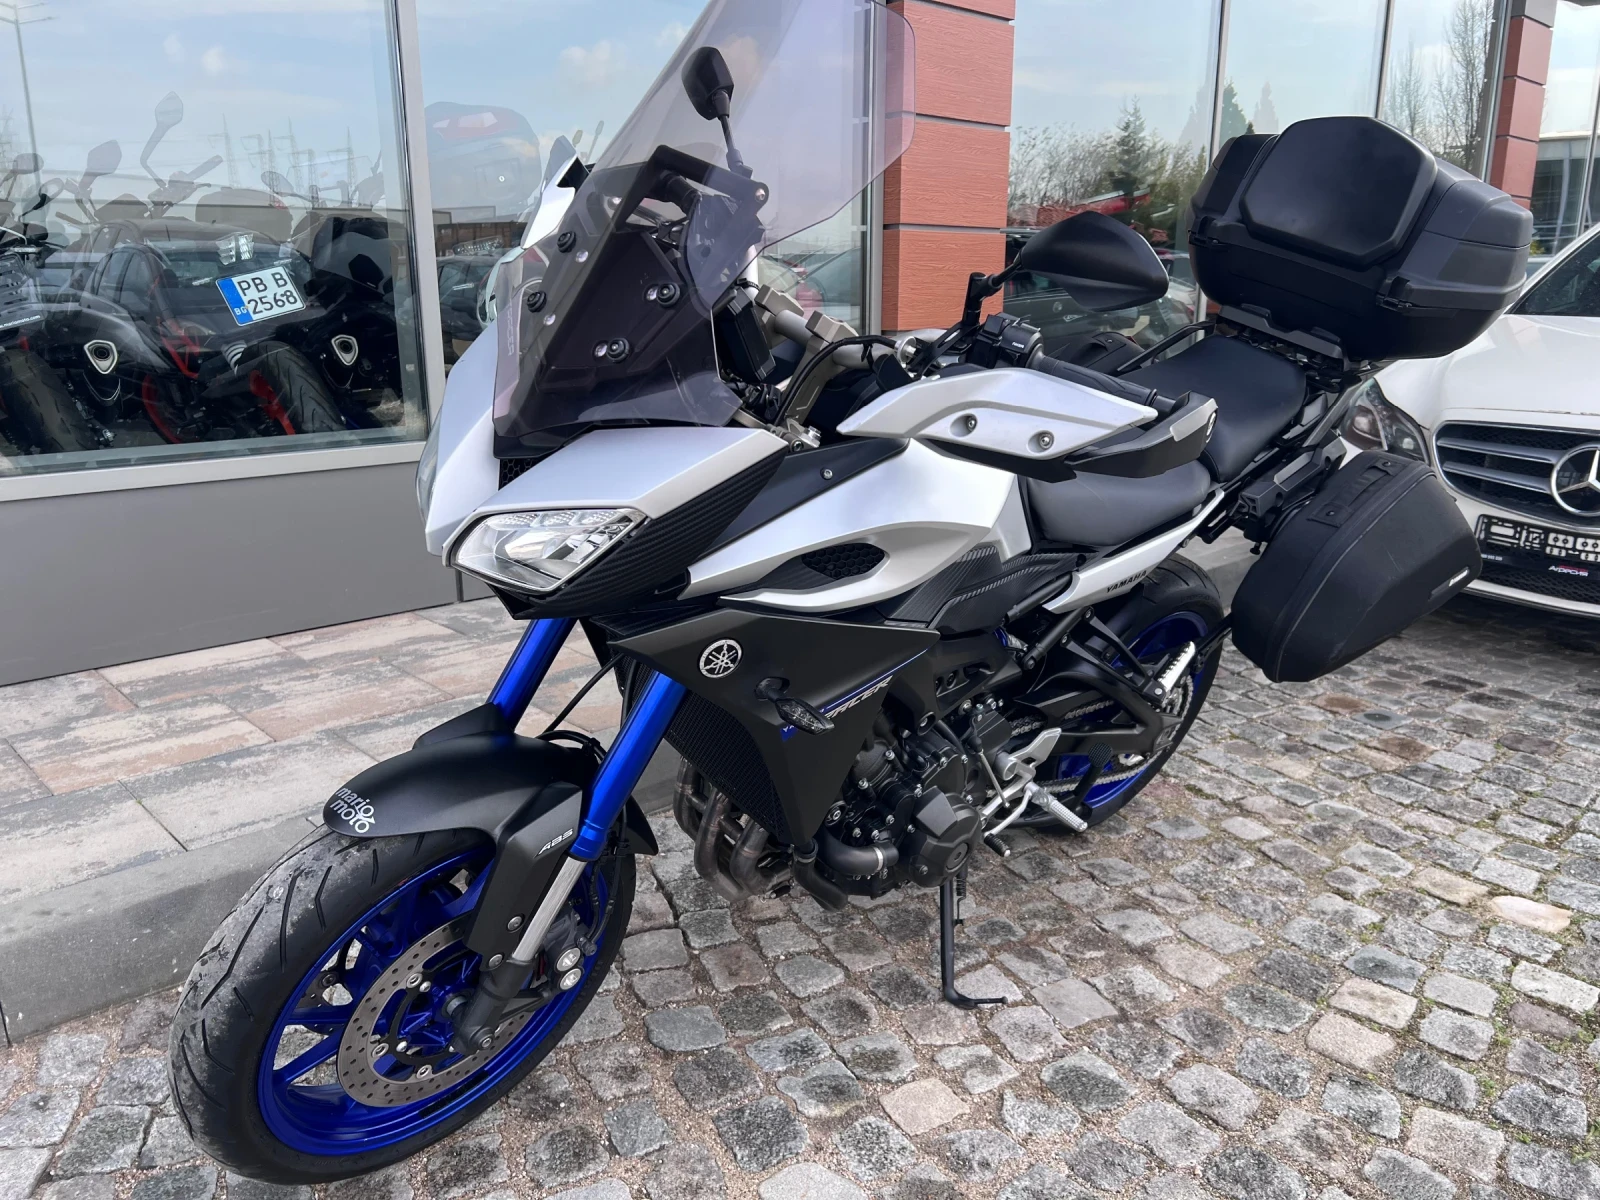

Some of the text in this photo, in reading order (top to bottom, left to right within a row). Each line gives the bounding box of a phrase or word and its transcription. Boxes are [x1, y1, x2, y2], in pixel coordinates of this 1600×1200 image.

[237, 272, 288, 296] PB B
[233, 306, 248, 315] BG
[248, 290, 297, 315] 2568
[1106, 570, 1147, 593] YAMAHA
[335, 787, 375, 817] mario
[330, 799, 376, 833] moto
[535, 828, 574, 857] ABS
